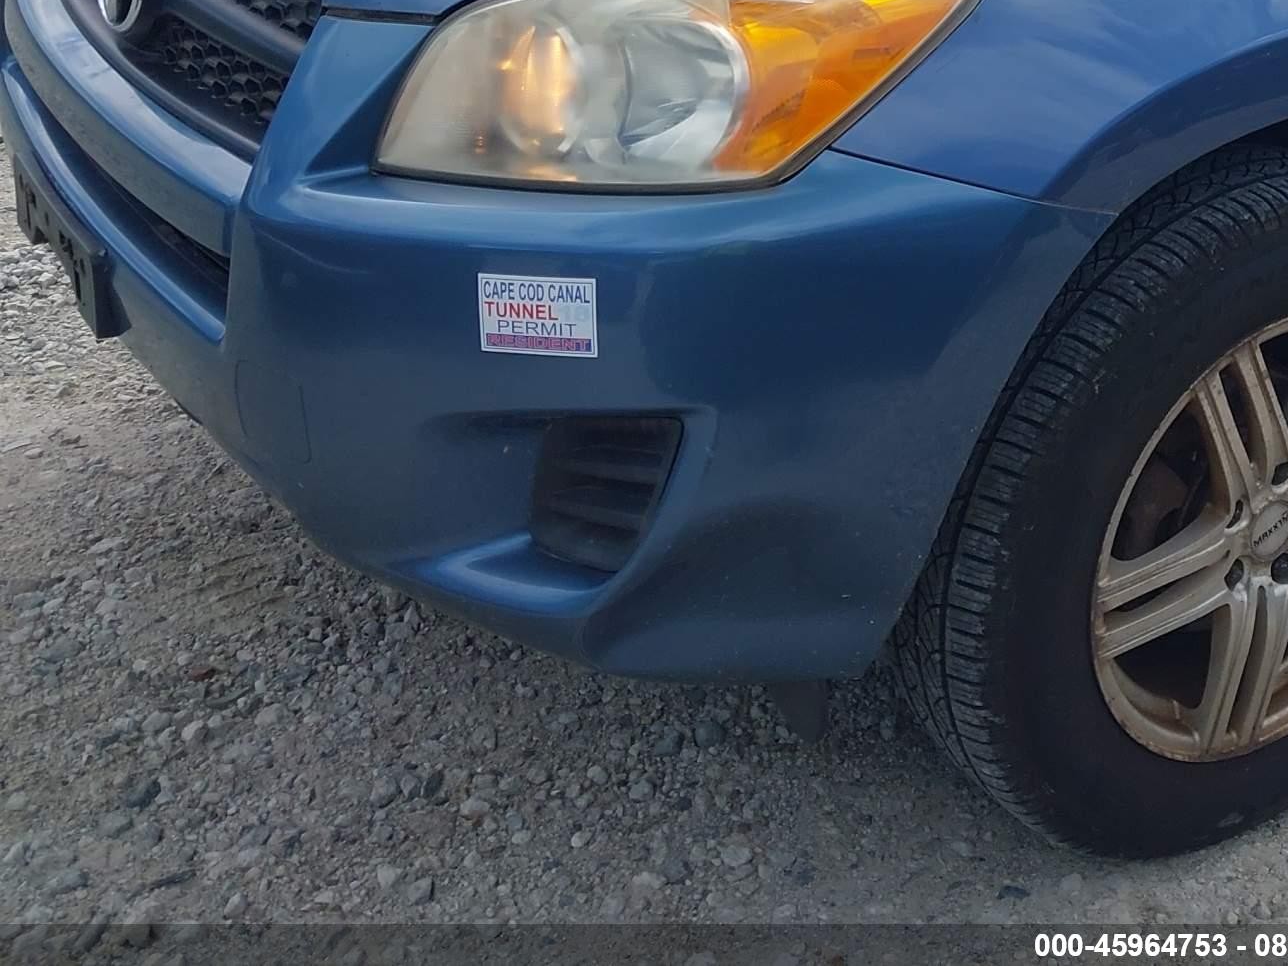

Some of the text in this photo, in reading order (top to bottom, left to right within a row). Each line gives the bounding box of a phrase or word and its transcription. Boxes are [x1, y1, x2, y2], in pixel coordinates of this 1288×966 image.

[483, 281, 590, 303] CAPE COD CANAL
[484, 301, 558, 320] TUNNEL
[497, 320, 577, 337] PERMIT
[487, 334, 590, 351] RESIDENT
